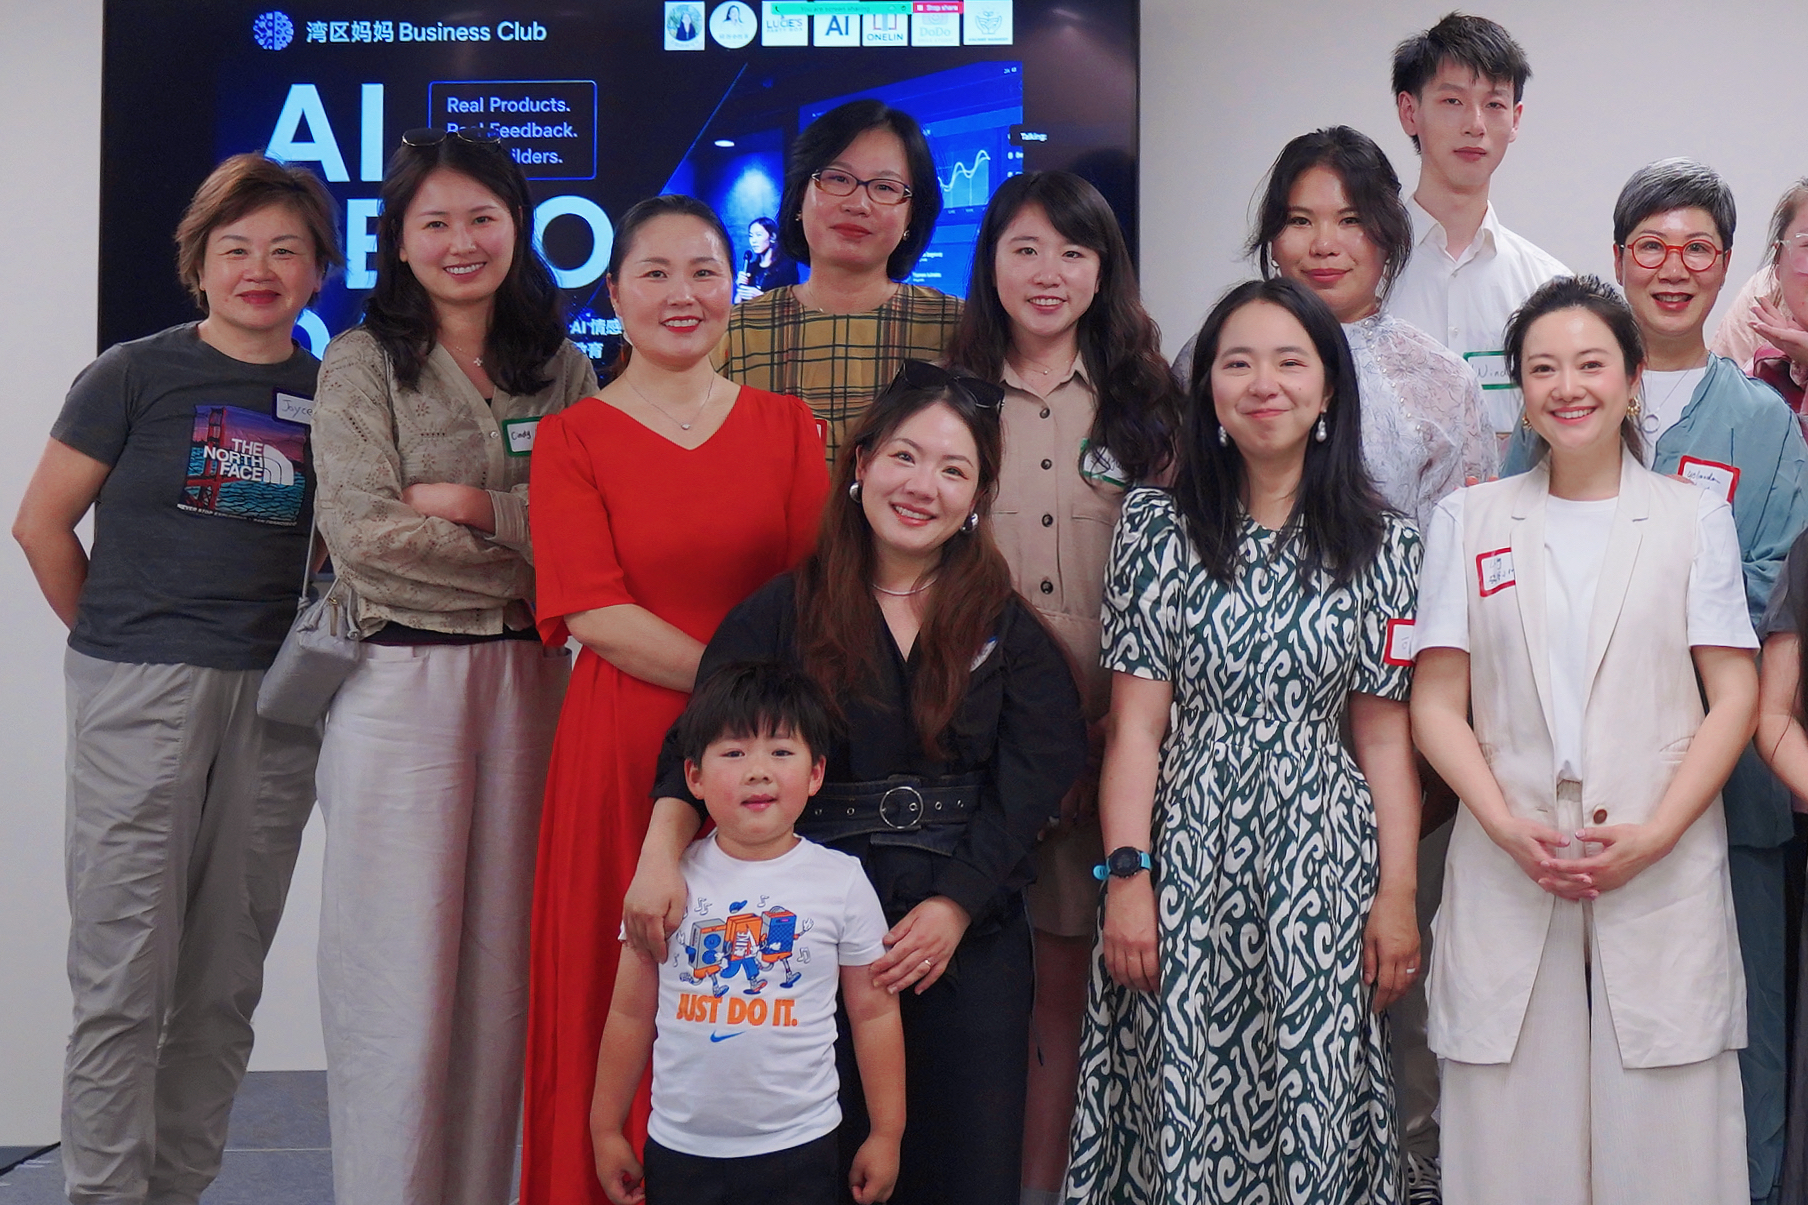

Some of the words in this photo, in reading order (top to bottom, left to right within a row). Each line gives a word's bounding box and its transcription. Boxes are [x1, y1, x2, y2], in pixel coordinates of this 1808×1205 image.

[306, 20, 395, 44] 湾区妈妈
[398, 21, 492, 42] Business
[496, 21, 548, 41] Club
[825, 14, 849, 36] AI
[919, 27, 951, 37] DoDo
[447, 96, 485, 113] Real
[489, 96, 571, 113] Products.
[263, 83, 384, 183] AI
[570, 319, 587, 334] AI
[281, 399, 313, 418] Joyce
[203, 445, 263, 468] NORTH
[231, 438, 263, 457] THE
[219, 462, 263, 482] FACE
[676, 993, 722, 1024] JUST
[727, 997, 768, 1026] DO
[772, 999, 798, 1027] IT.
